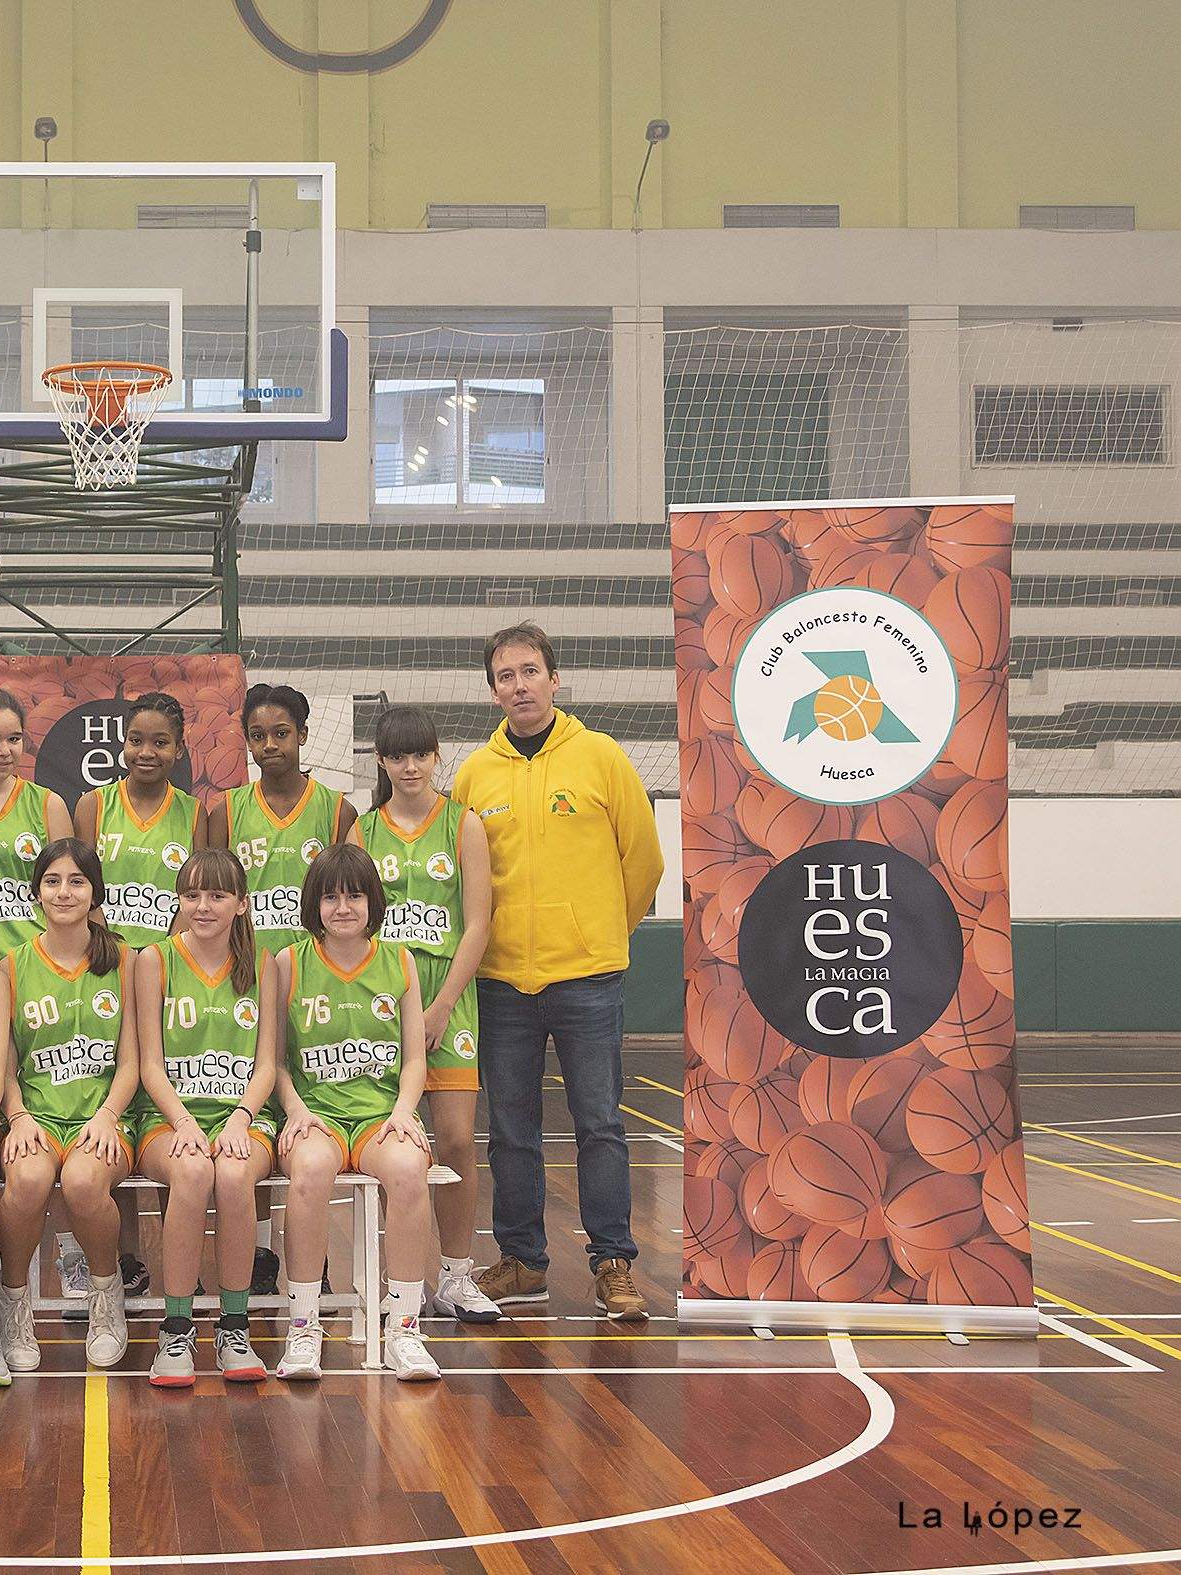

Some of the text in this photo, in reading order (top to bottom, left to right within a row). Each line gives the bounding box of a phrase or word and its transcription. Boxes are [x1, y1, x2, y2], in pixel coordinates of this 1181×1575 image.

[760, 610, 929, 678] Club Baloncesto Femenino
[819, 764, 875, 781] Huesca
[236, 837, 268, 871] 85
[105, 885, 180, 914] uesca
[803, 908, 893, 961] es
[23, 995, 60, 1030] 90
[164, 996, 197, 1030] 70
[301, 994, 332, 1028] 76
[805, 986, 898, 1036] ca
[303, 1042, 399, 1069] Huesca
